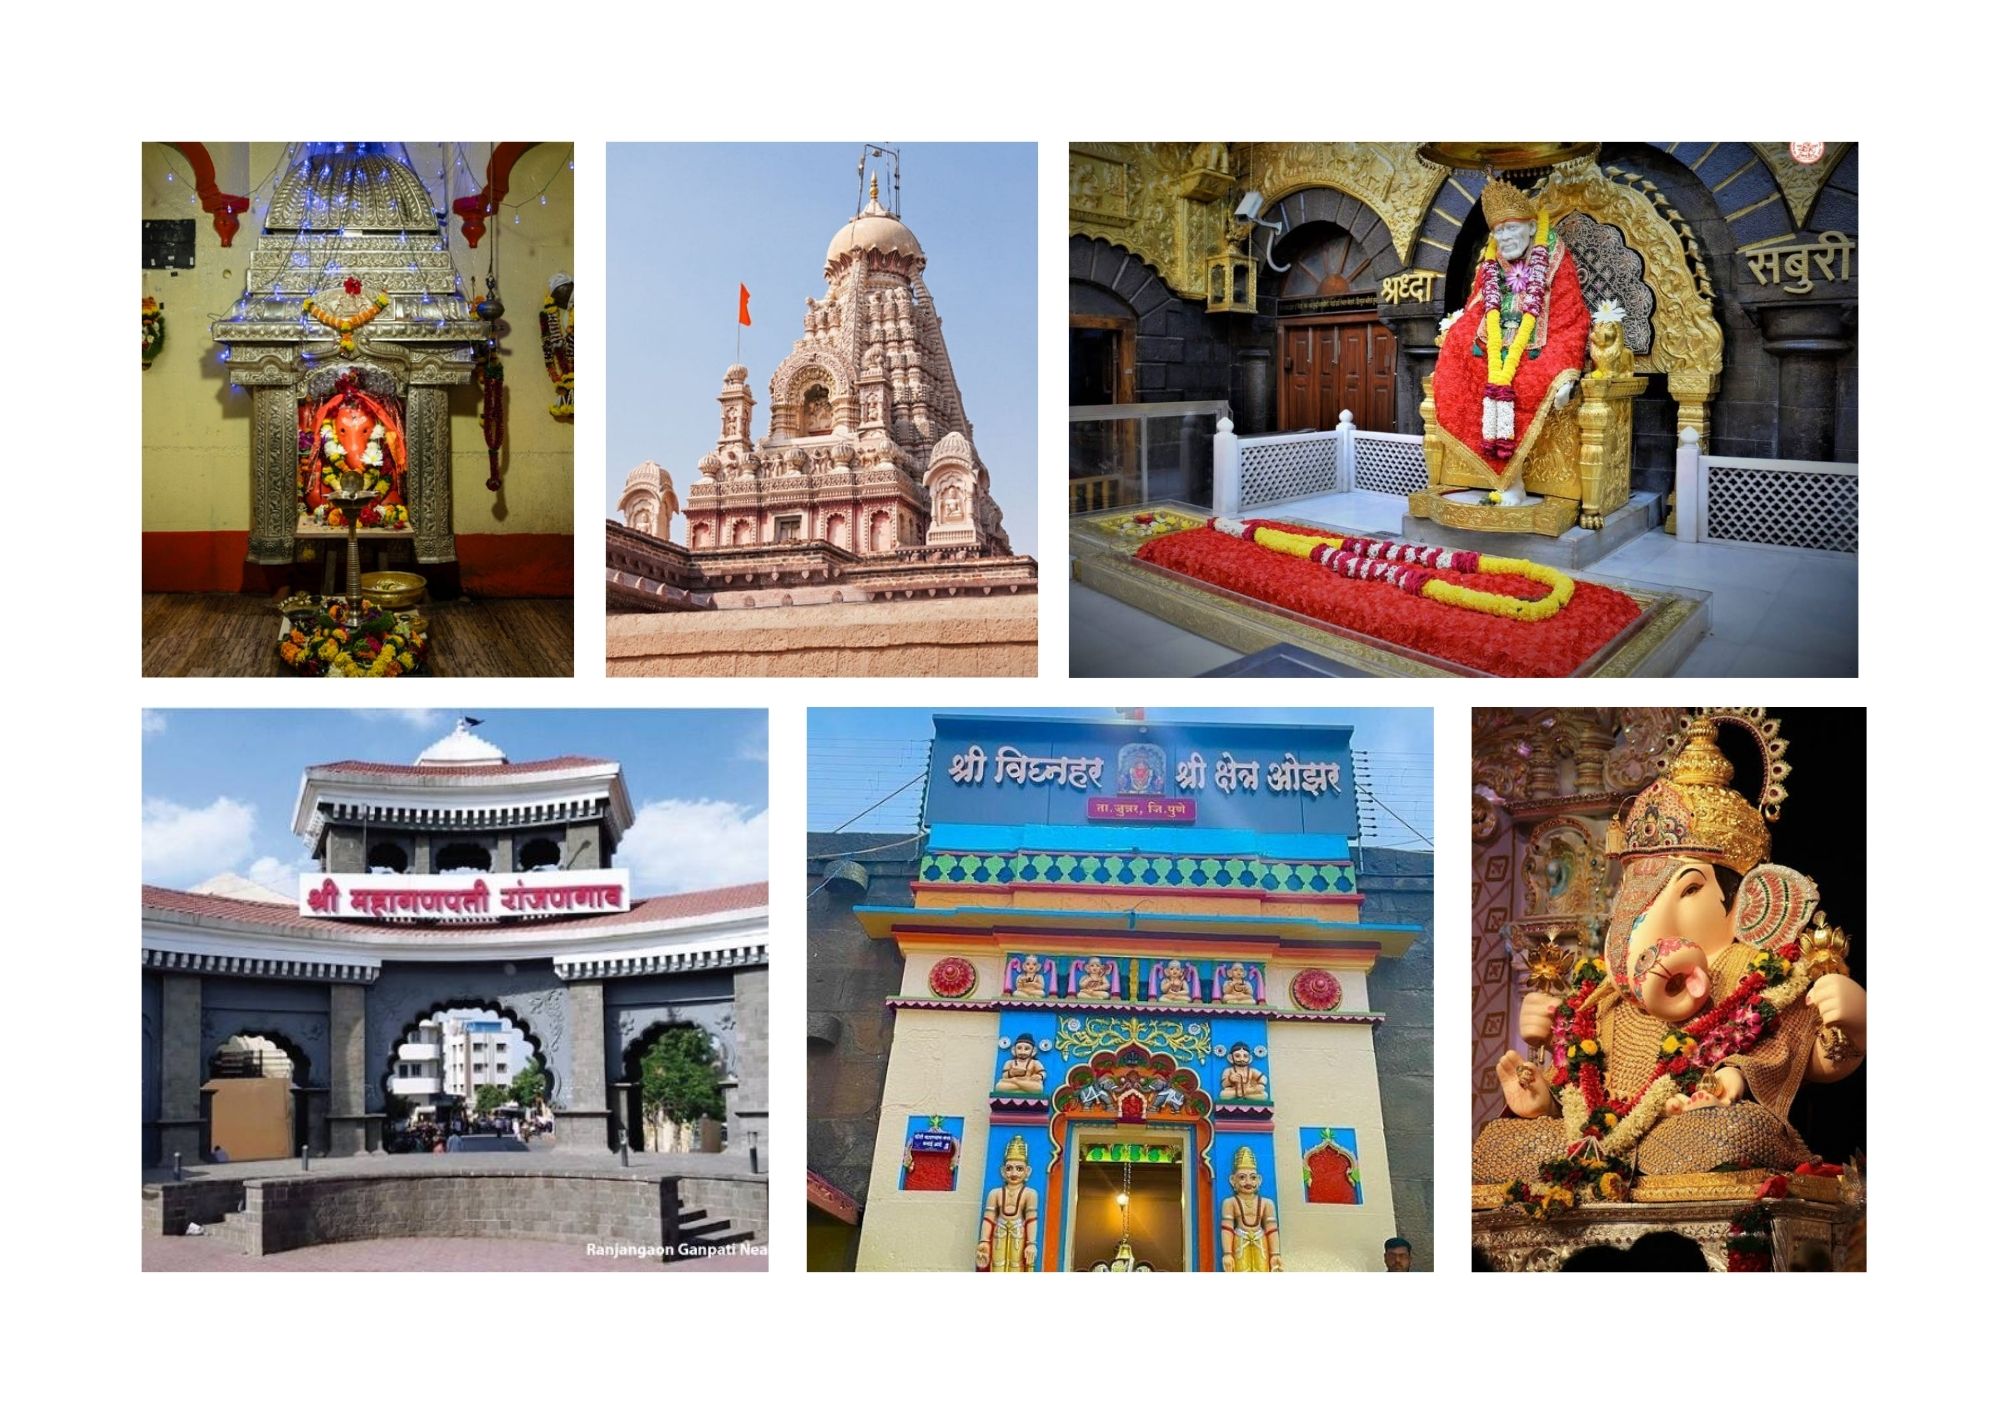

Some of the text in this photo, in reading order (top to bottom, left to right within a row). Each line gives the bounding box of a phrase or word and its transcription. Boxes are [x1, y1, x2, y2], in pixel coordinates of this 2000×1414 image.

[1745, 231, 1855, 294] सबुरी
[948, 745, 1341, 796] श्री विघ्नहर श्री क्षेत्र ओझर
[307, 878, 624, 917] श्री महागणपती रांजणगाव
